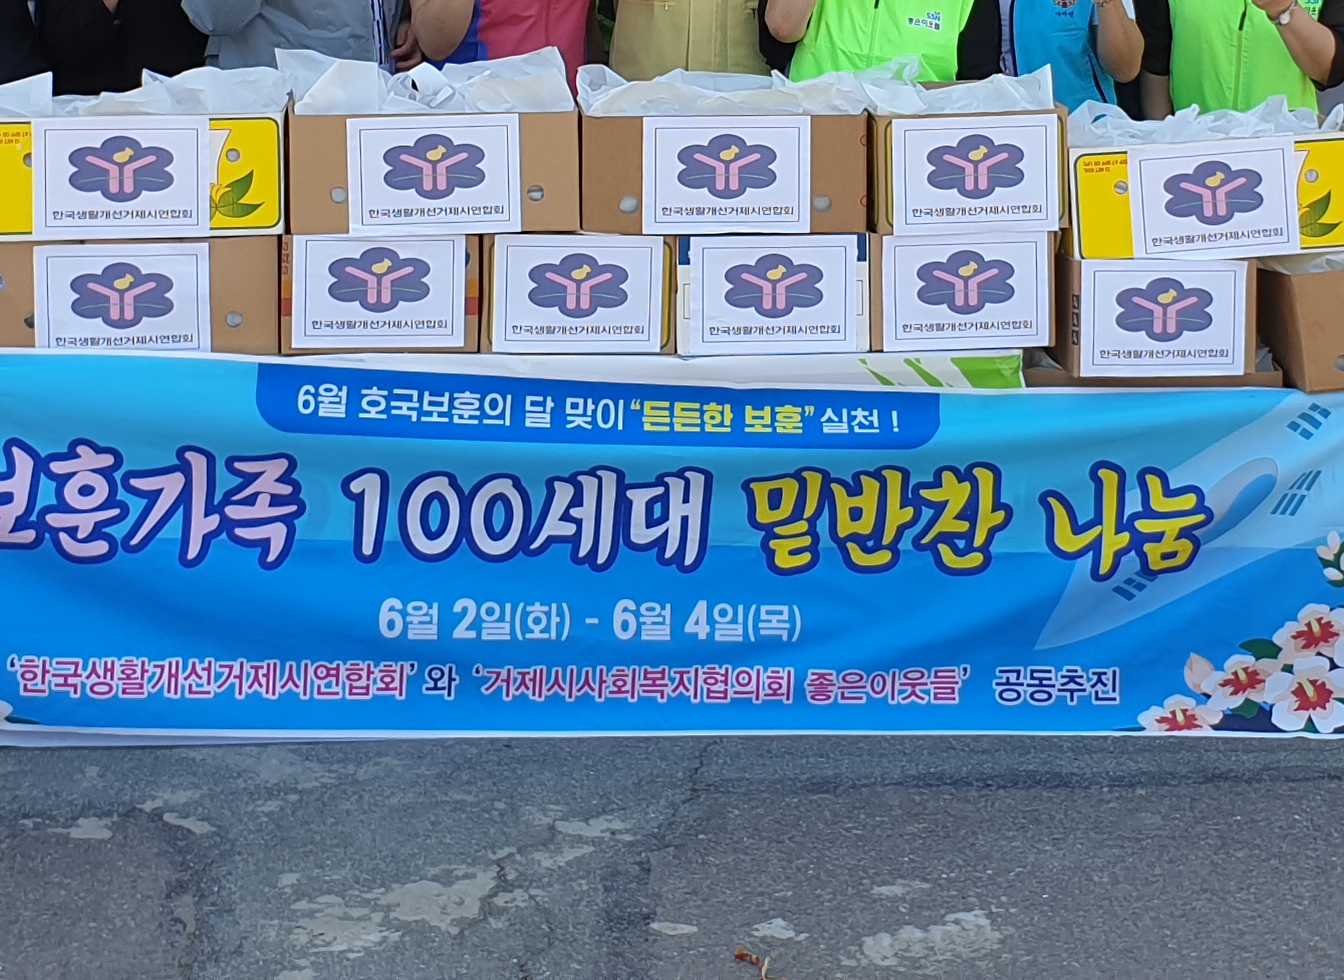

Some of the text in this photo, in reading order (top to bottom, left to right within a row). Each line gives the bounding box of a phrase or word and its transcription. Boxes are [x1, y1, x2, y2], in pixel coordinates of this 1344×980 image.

[51, 207, 194, 222] 한국생활개선거제시연합회
[368, 203, 505, 220] 한국생활개선거제시연합회
[661, 203, 795, 219] 한국생활개선거제시연합회
[911, 202, 1043, 219] 한국생활개선거제시연합회
[1151, 224, 1285, 249] 한국생활개선거제시연합회
[310, 316, 448, 332] 한국생활개선거제시연합회
[511, 322, 646, 337] 한국생활개선거제시연합회
[708, 322, 842, 337] 한국생활개선거제시연합회
[901, 318, 1034, 334] 한국생활개선거제시연합회
[54, 331, 195, 347] 한국생활개선거제시연합회
[1098, 345, 1230, 361] 한국생활개선거제시연합회
[296, 383, 349, 419] 6월
[358, 386, 514, 428] 호국보훈의
[524, 390, 556, 430] 달
[344, 463, 708, 570] 100세대
[747, 461, 1012, 575] 밑반찬
[1041, 462, 1212, 580] 나눔
[378, 598, 440, 641] 6월
[451, 598, 571, 644] 2일(화)
[611, 600, 673, 643] 6월
[684, 600, 803, 645] 4일(목)
[424, 665, 457, 702] 와
[992, 665, 1120, 707] 공동추진
